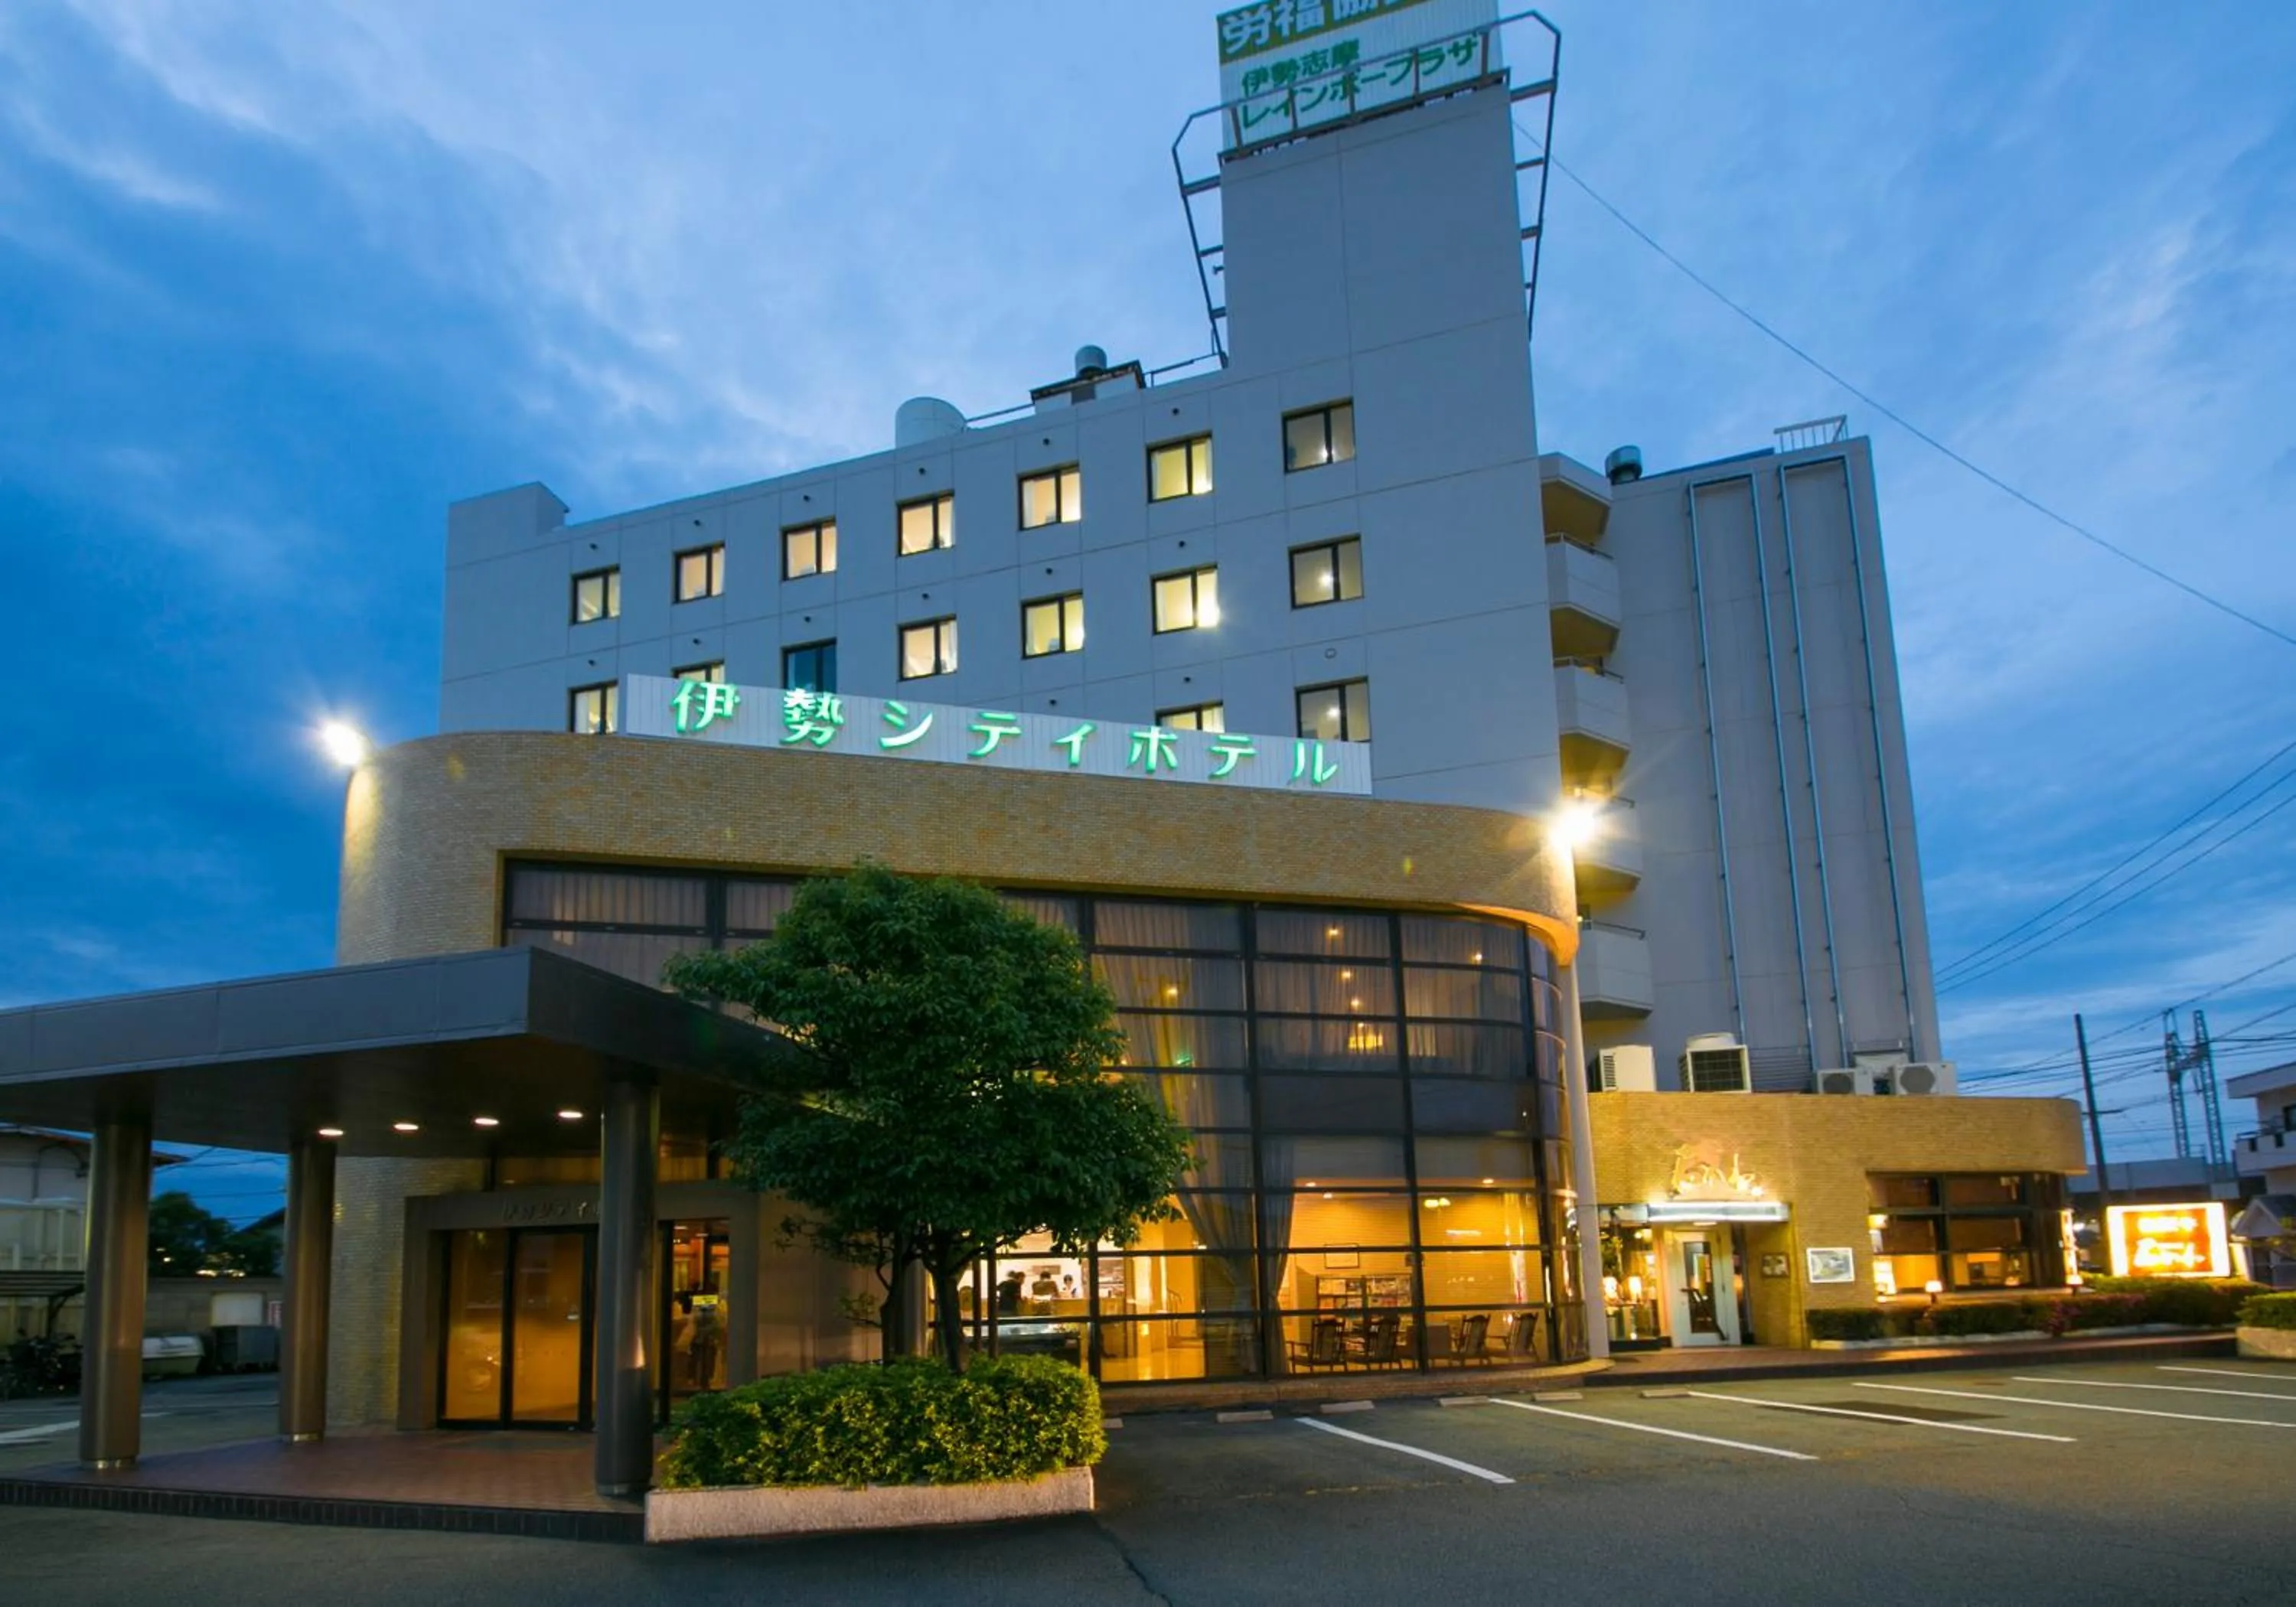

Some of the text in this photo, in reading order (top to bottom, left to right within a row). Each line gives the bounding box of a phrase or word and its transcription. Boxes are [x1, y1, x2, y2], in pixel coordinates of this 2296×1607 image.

[1223, 0, 1407, 54] 労福
[1242, 37, 1359, 97] 伊勢志摩
[671, 675, 1339, 786] 伊勢シティホテル
